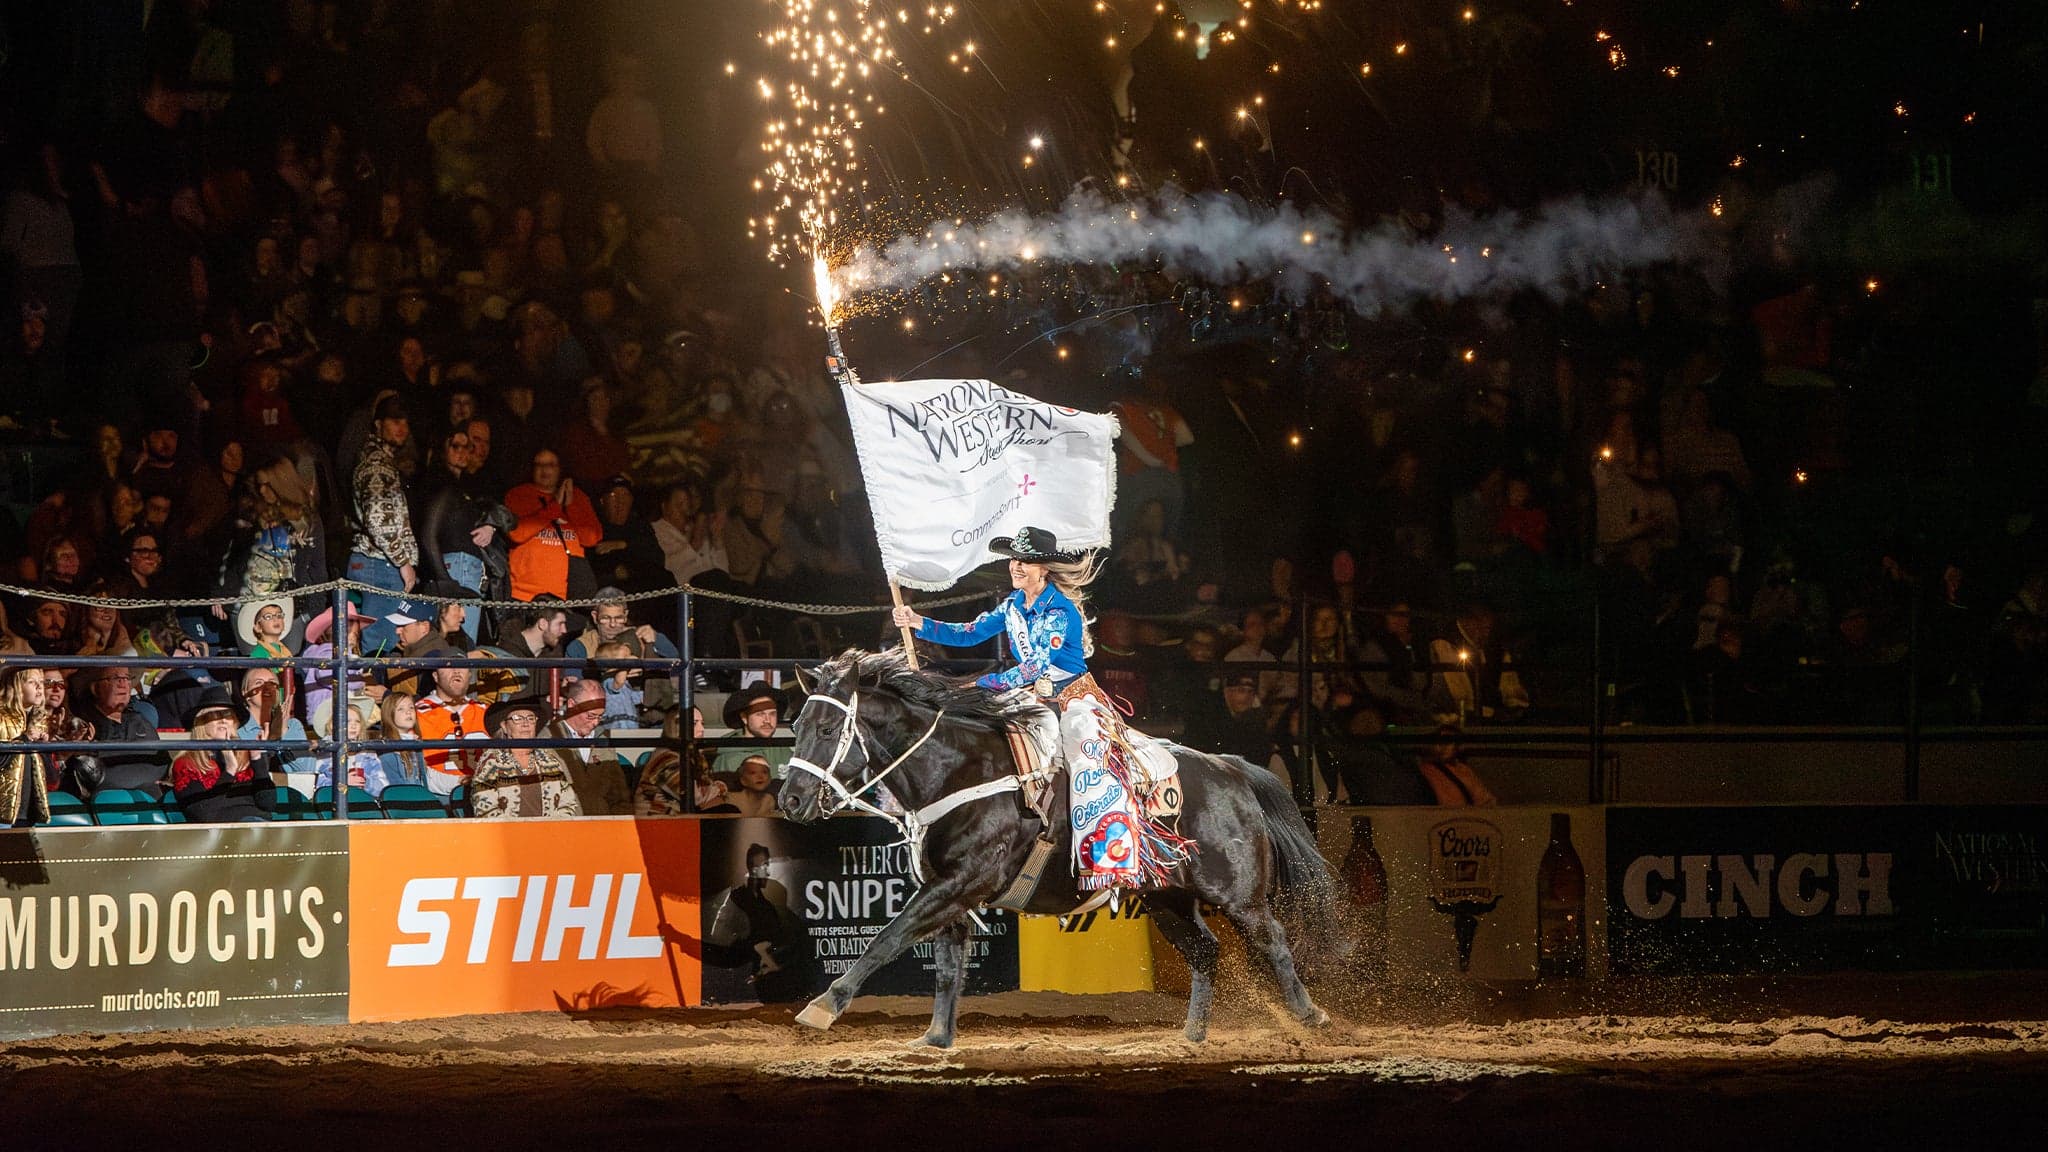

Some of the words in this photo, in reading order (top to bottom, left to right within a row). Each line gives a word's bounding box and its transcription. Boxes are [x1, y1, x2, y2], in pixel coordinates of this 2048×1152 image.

[886, 380, 1026, 437] NATIONA
[1003, 428, 1068, 450] Show
[1073, 785, 1122, 829] Colorado
[1438, 827, 1491, 857] Coors
[839, 846, 894, 875] TYLER
[805, 878, 905, 920] SNIPE
[1622, 852, 1895, 920] CINCH
[0, 886, 325, 971] MURDOCH'S
[387, 873, 665, 967] STIHL
[808, 926, 827, 936] WITH
[828, 925, 859, 936] SPECIAL
[814, 938, 838, 959] JON
[840, 937, 872, 955] BATIS
[101, 987, 220, 1013] murdochs.com
